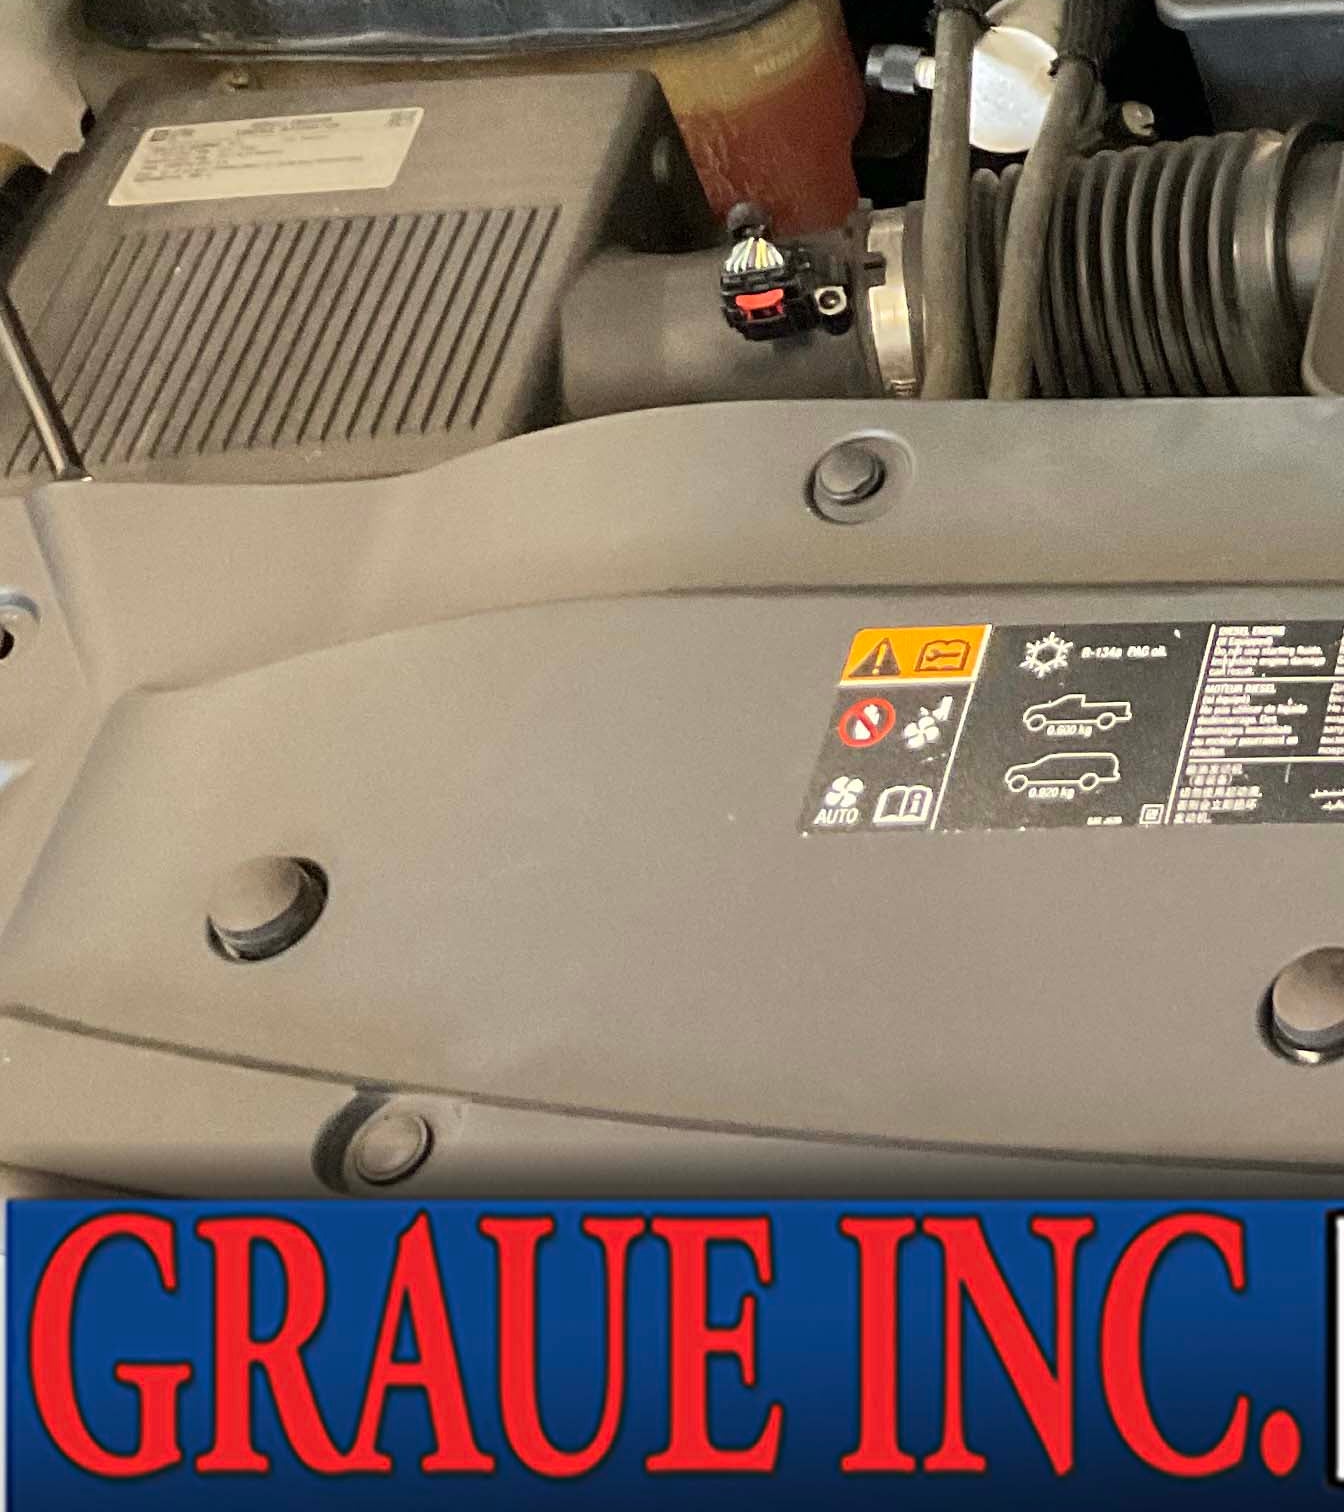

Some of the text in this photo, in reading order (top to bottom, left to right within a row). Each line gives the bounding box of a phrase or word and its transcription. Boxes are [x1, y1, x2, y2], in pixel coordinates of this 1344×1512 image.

[1127, 645, 1151, 658] PAG
[1078, 724, 1093, 738] kg
[813, 808, 859, 824] AUTO
